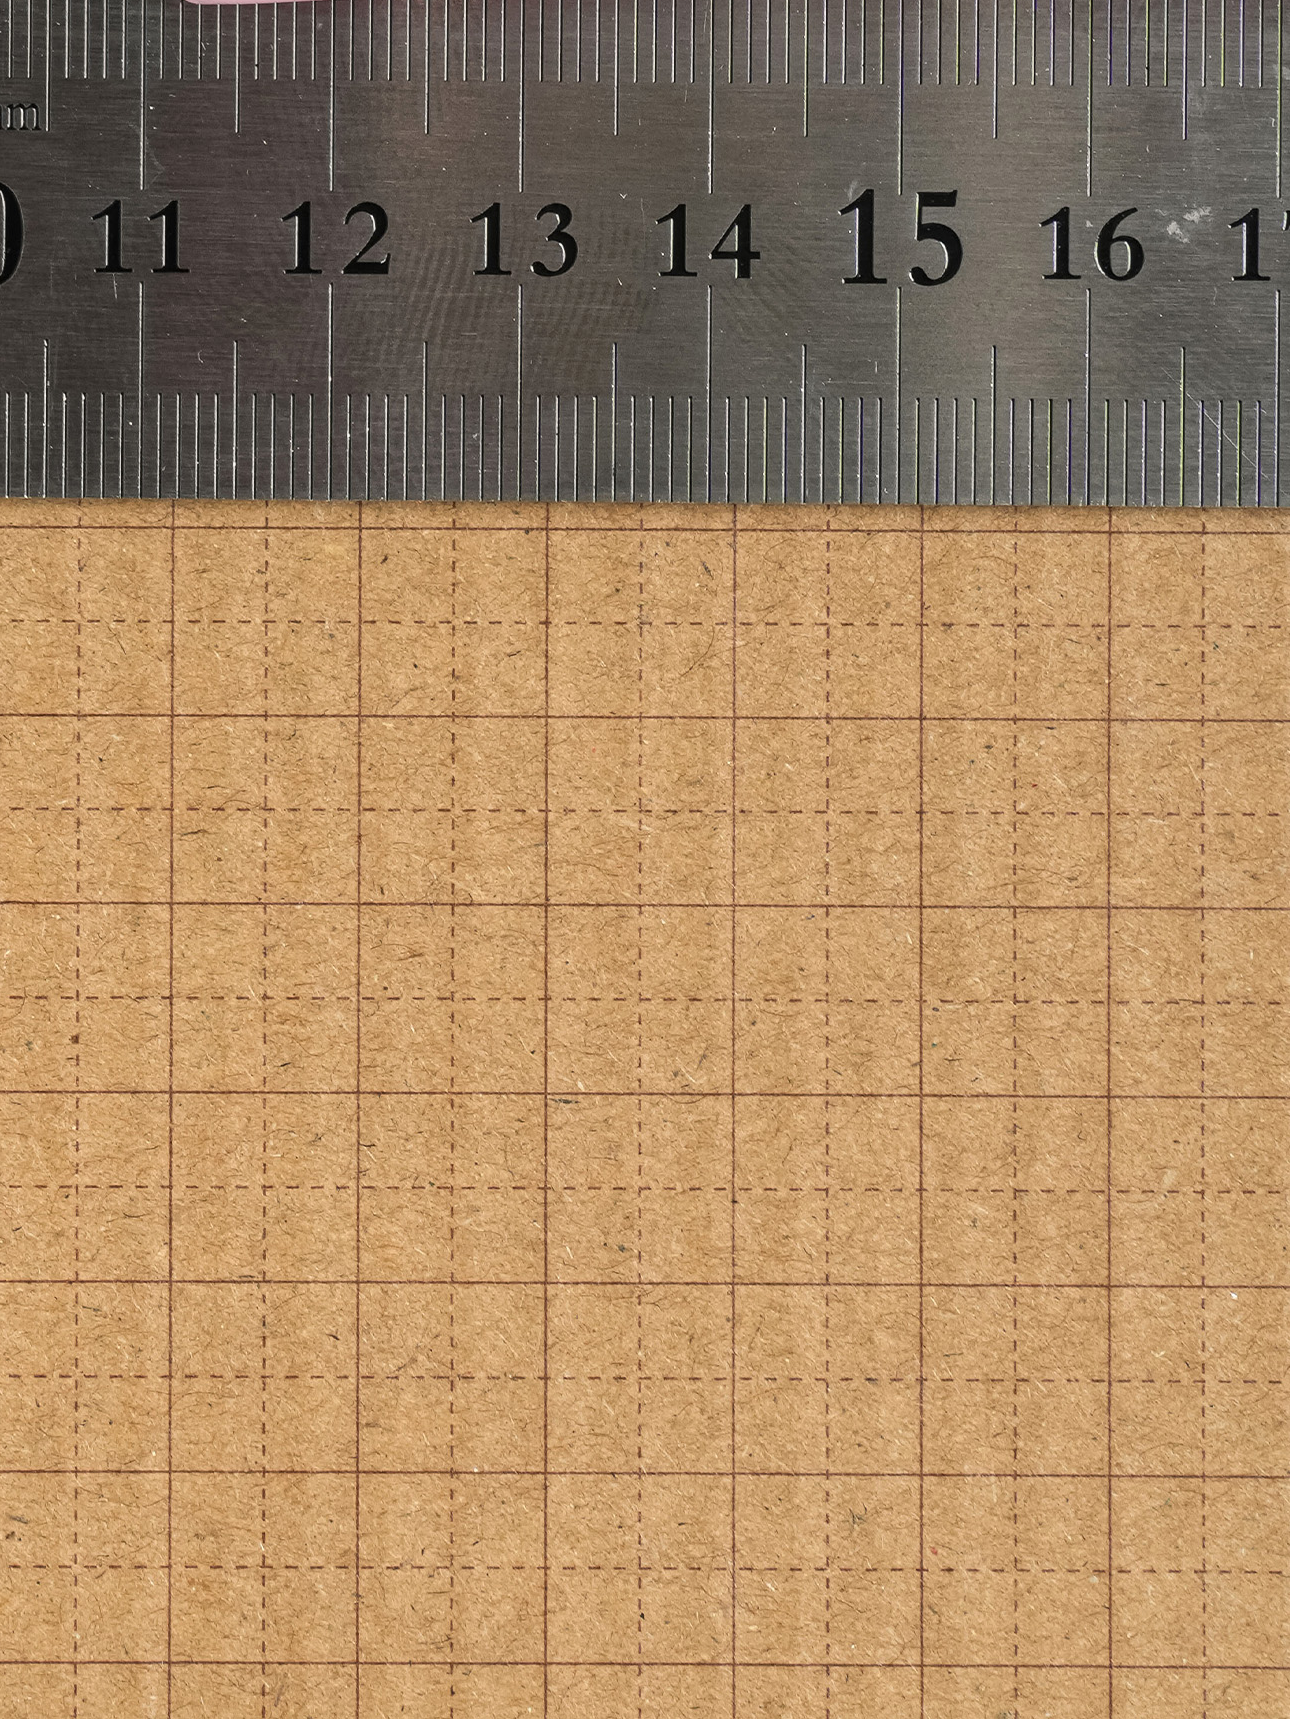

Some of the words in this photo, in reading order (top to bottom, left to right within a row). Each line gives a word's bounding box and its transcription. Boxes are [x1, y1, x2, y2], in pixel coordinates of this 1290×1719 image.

[93, 200, 189, 273] 11
[282, 201, 390, 274] 12
[471, 203, 577, 276] 13
[657, 204, 760, 278] 14
[840, 189, 962, 286] 15
[1041, 207, 1144, 281] 16
[1228, 208, 1290, 281] 1
